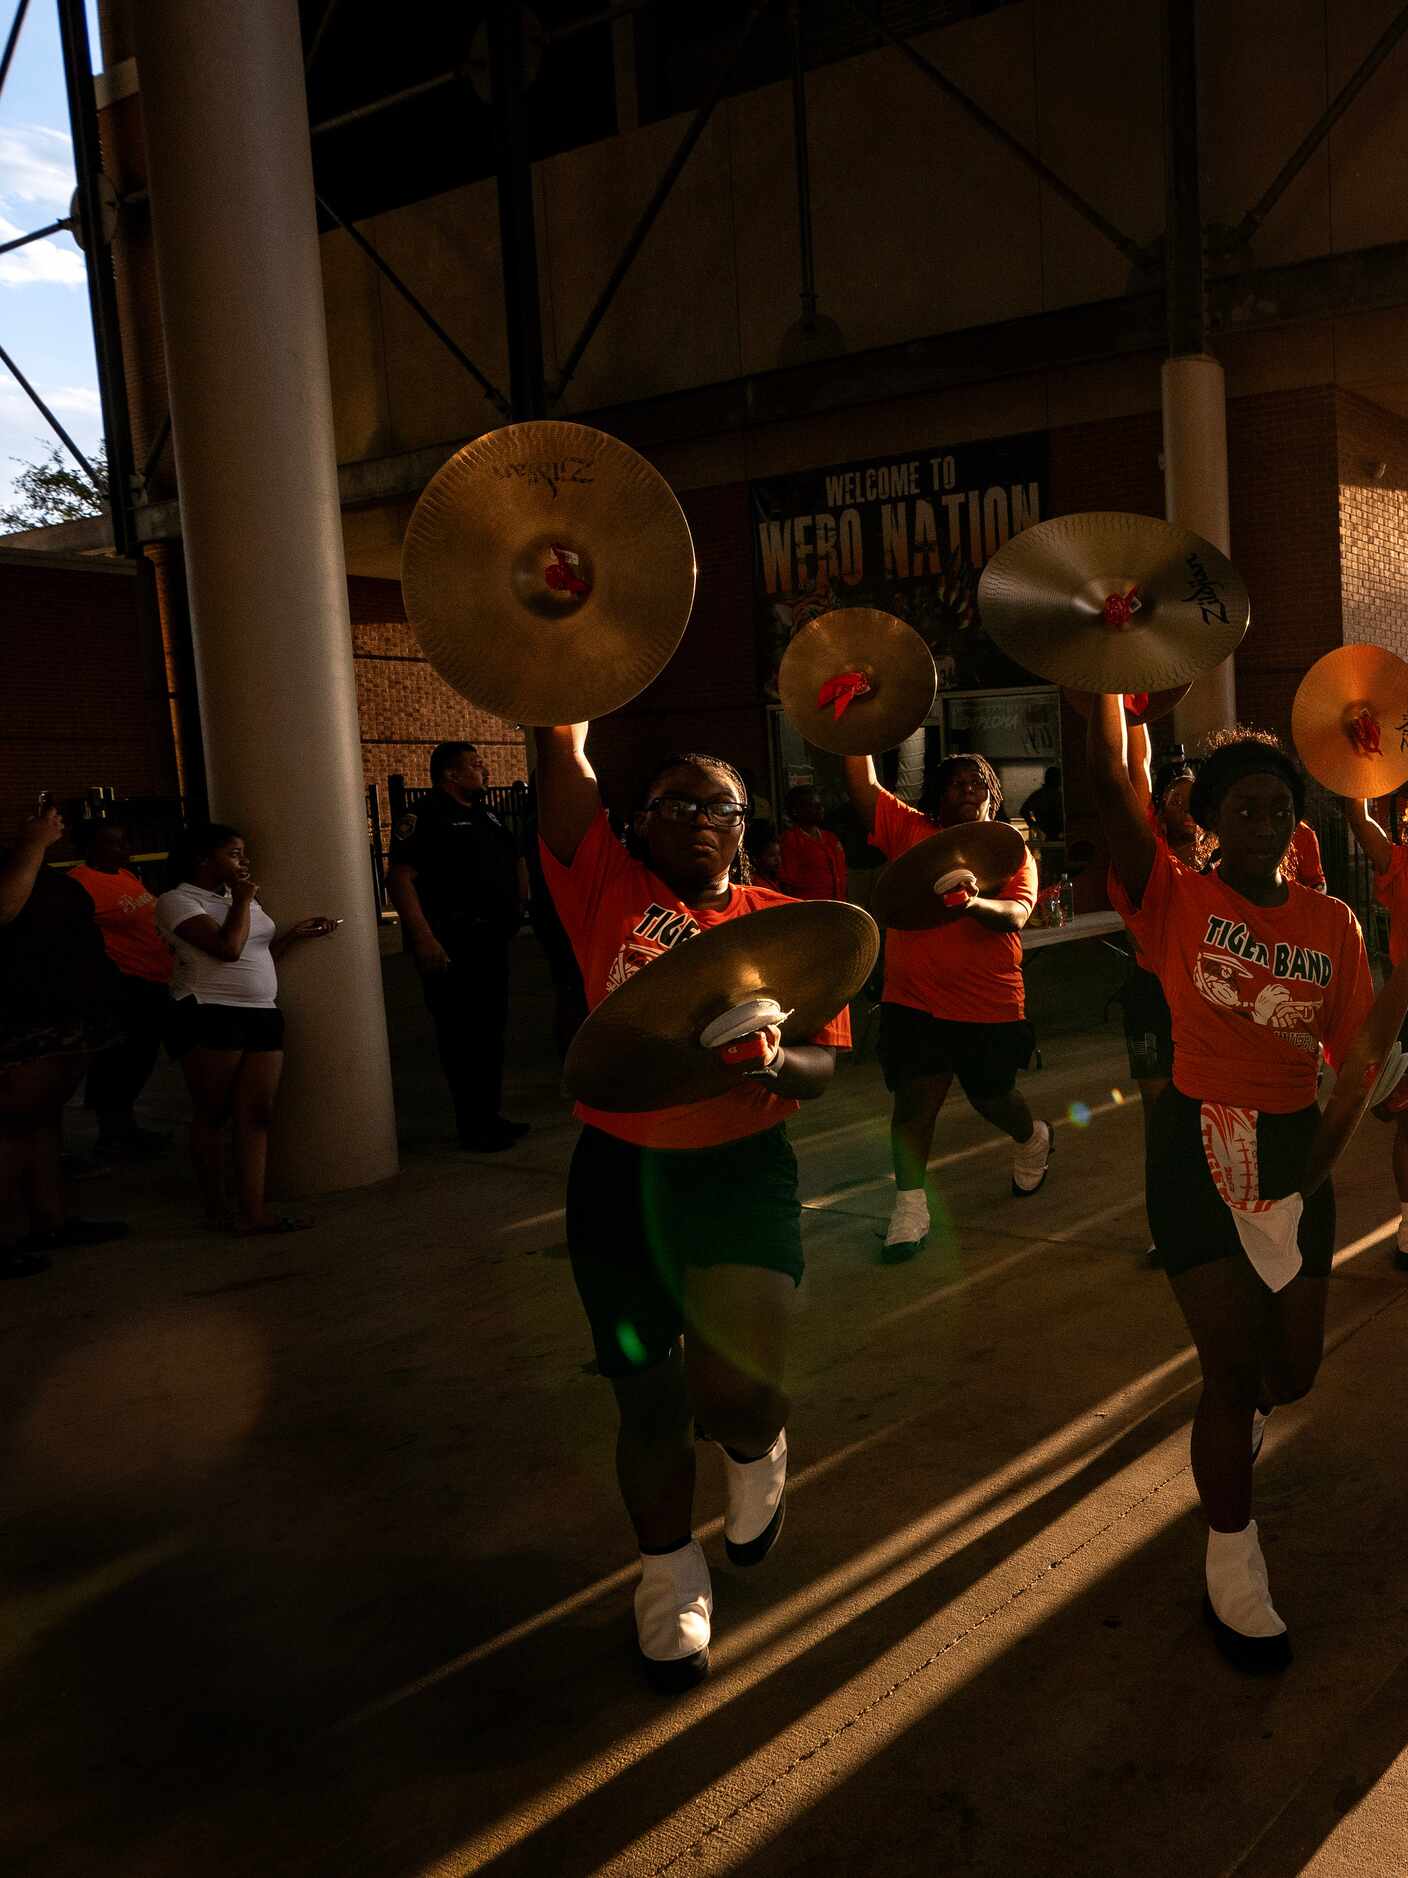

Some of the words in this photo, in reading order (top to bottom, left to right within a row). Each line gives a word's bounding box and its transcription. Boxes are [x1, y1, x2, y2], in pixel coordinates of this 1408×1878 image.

[825, 460, 920, 508] WELCOME
[930, 455, 957, 492] TO
[880, 481, 1040, 576] NATION
[1181, 551, 1230, 625] Zildjian
[633, 902, 701, 949] TIGE
[1204, 914, 1270, 968] TIGER
[1272, 942, 1333, 989] BAND
